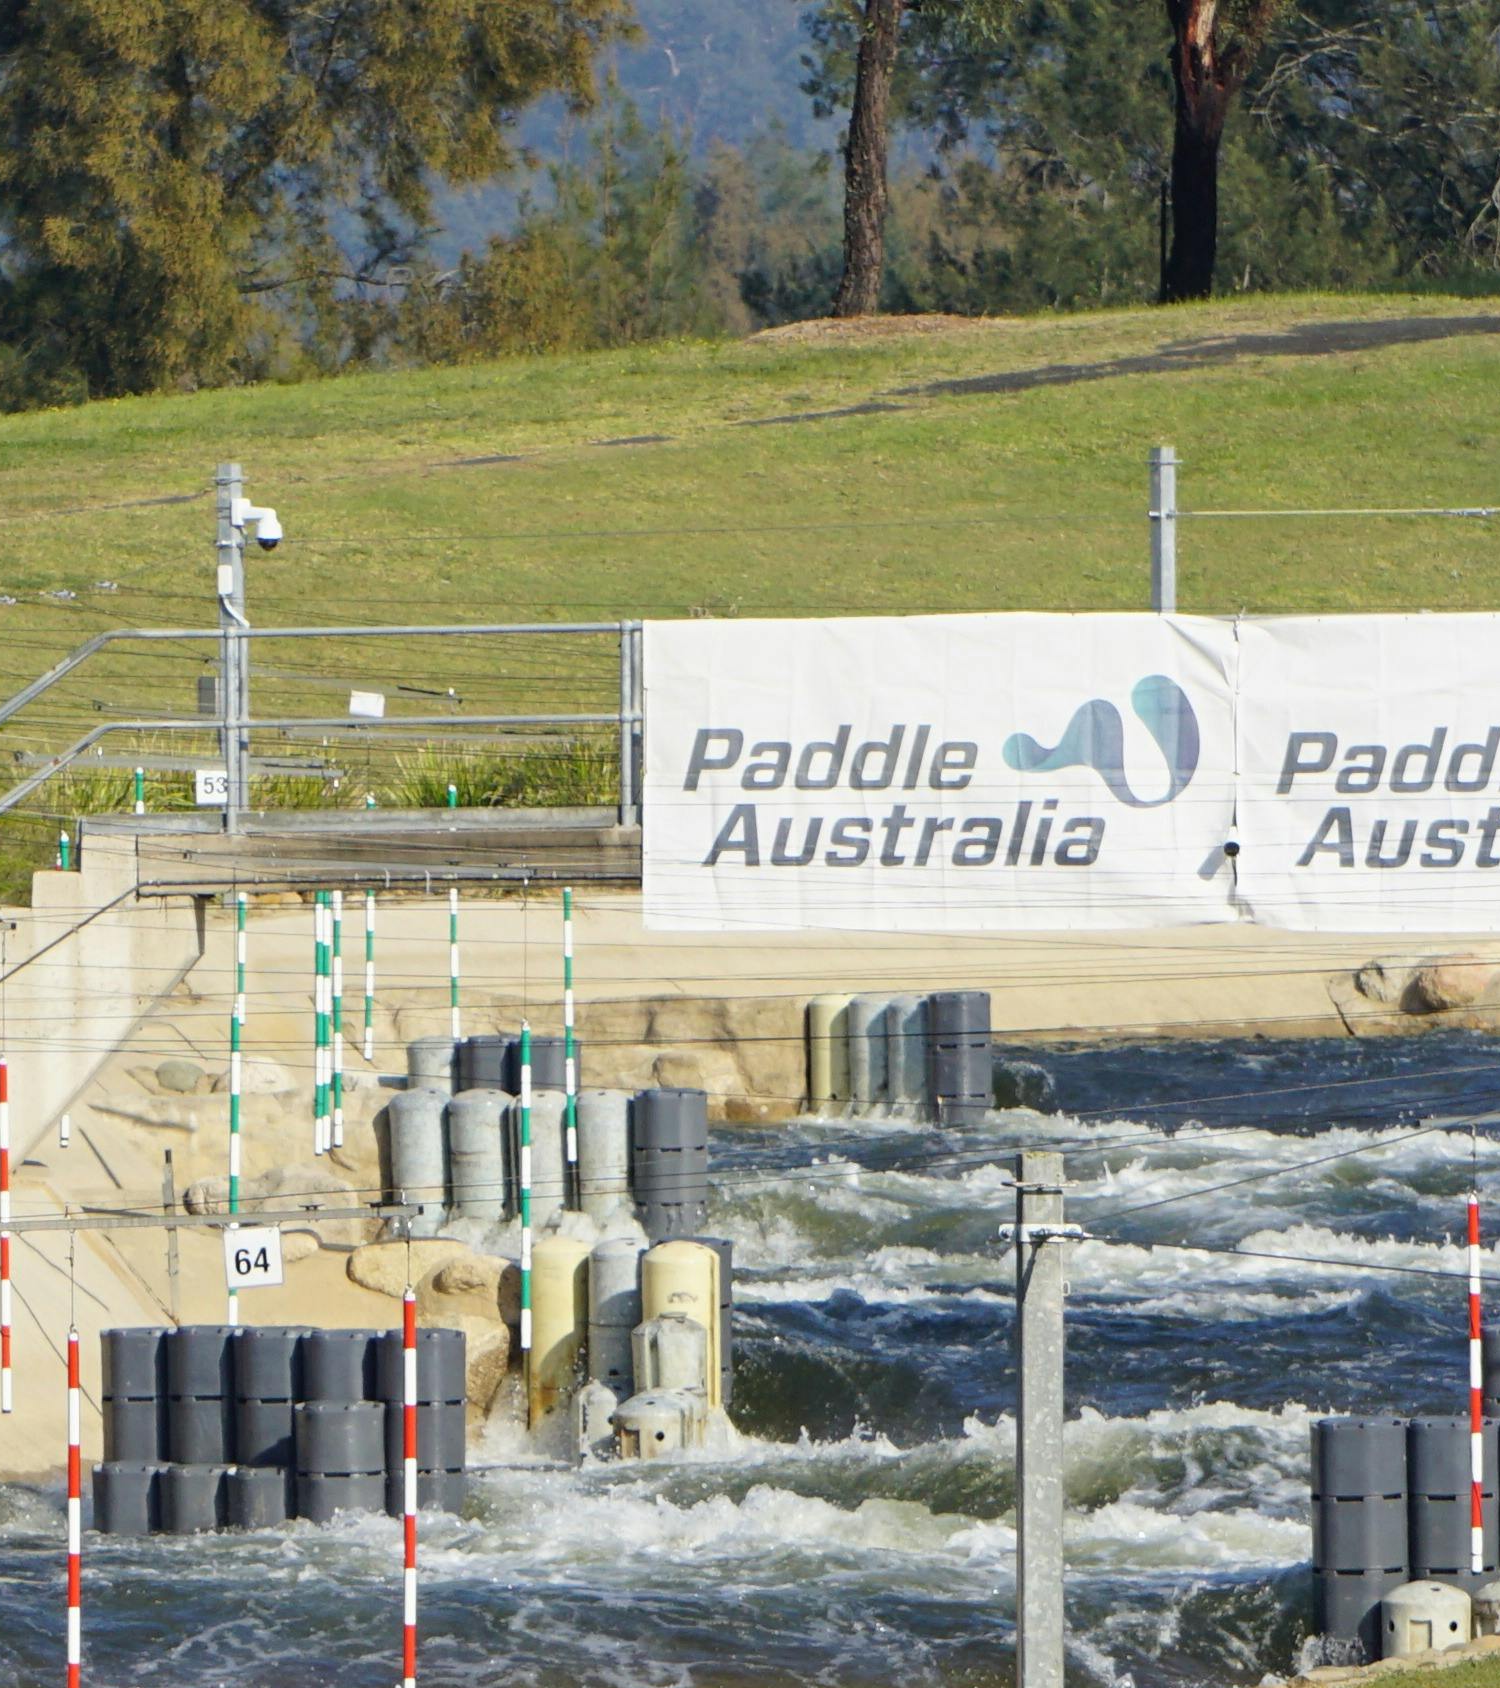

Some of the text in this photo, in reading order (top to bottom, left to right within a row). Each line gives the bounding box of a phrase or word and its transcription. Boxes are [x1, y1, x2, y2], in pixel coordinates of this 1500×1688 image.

[684, 724, 978, 792] Paddle
[204, 776, 228, 794] 53
[702, 799, 1107, 868] Australia
[235, 1247, 270, 1275] 64
